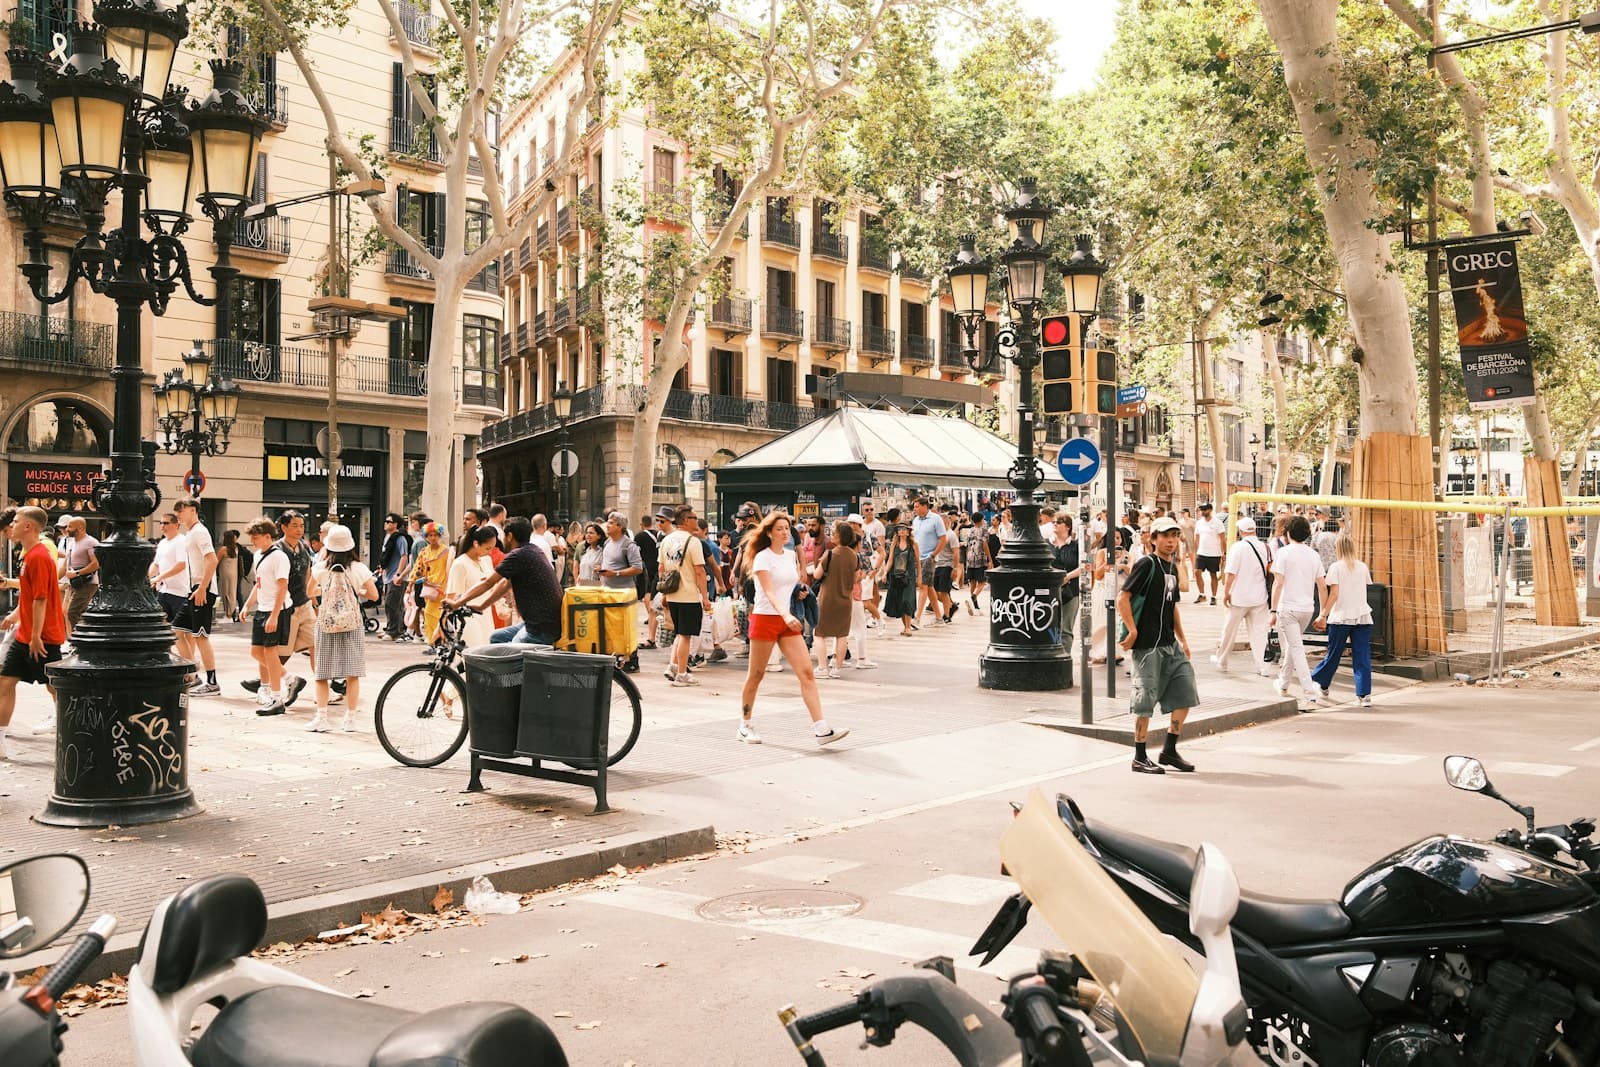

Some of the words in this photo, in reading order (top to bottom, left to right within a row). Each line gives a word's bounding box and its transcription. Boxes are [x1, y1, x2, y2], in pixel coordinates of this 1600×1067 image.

[1452, 250, 1513, 273] GREC
[1478, 353, 1514, 362] FESTIVAL
[1466, 363, 1478, 372] DE
[1478, 358, 1527, 370] BARCELONA
[1477, 368, 1499, 377] ESTIU
[346, 464, 374, 478] COMPANY
[27, 482, 69, 494] GEMÜSE
